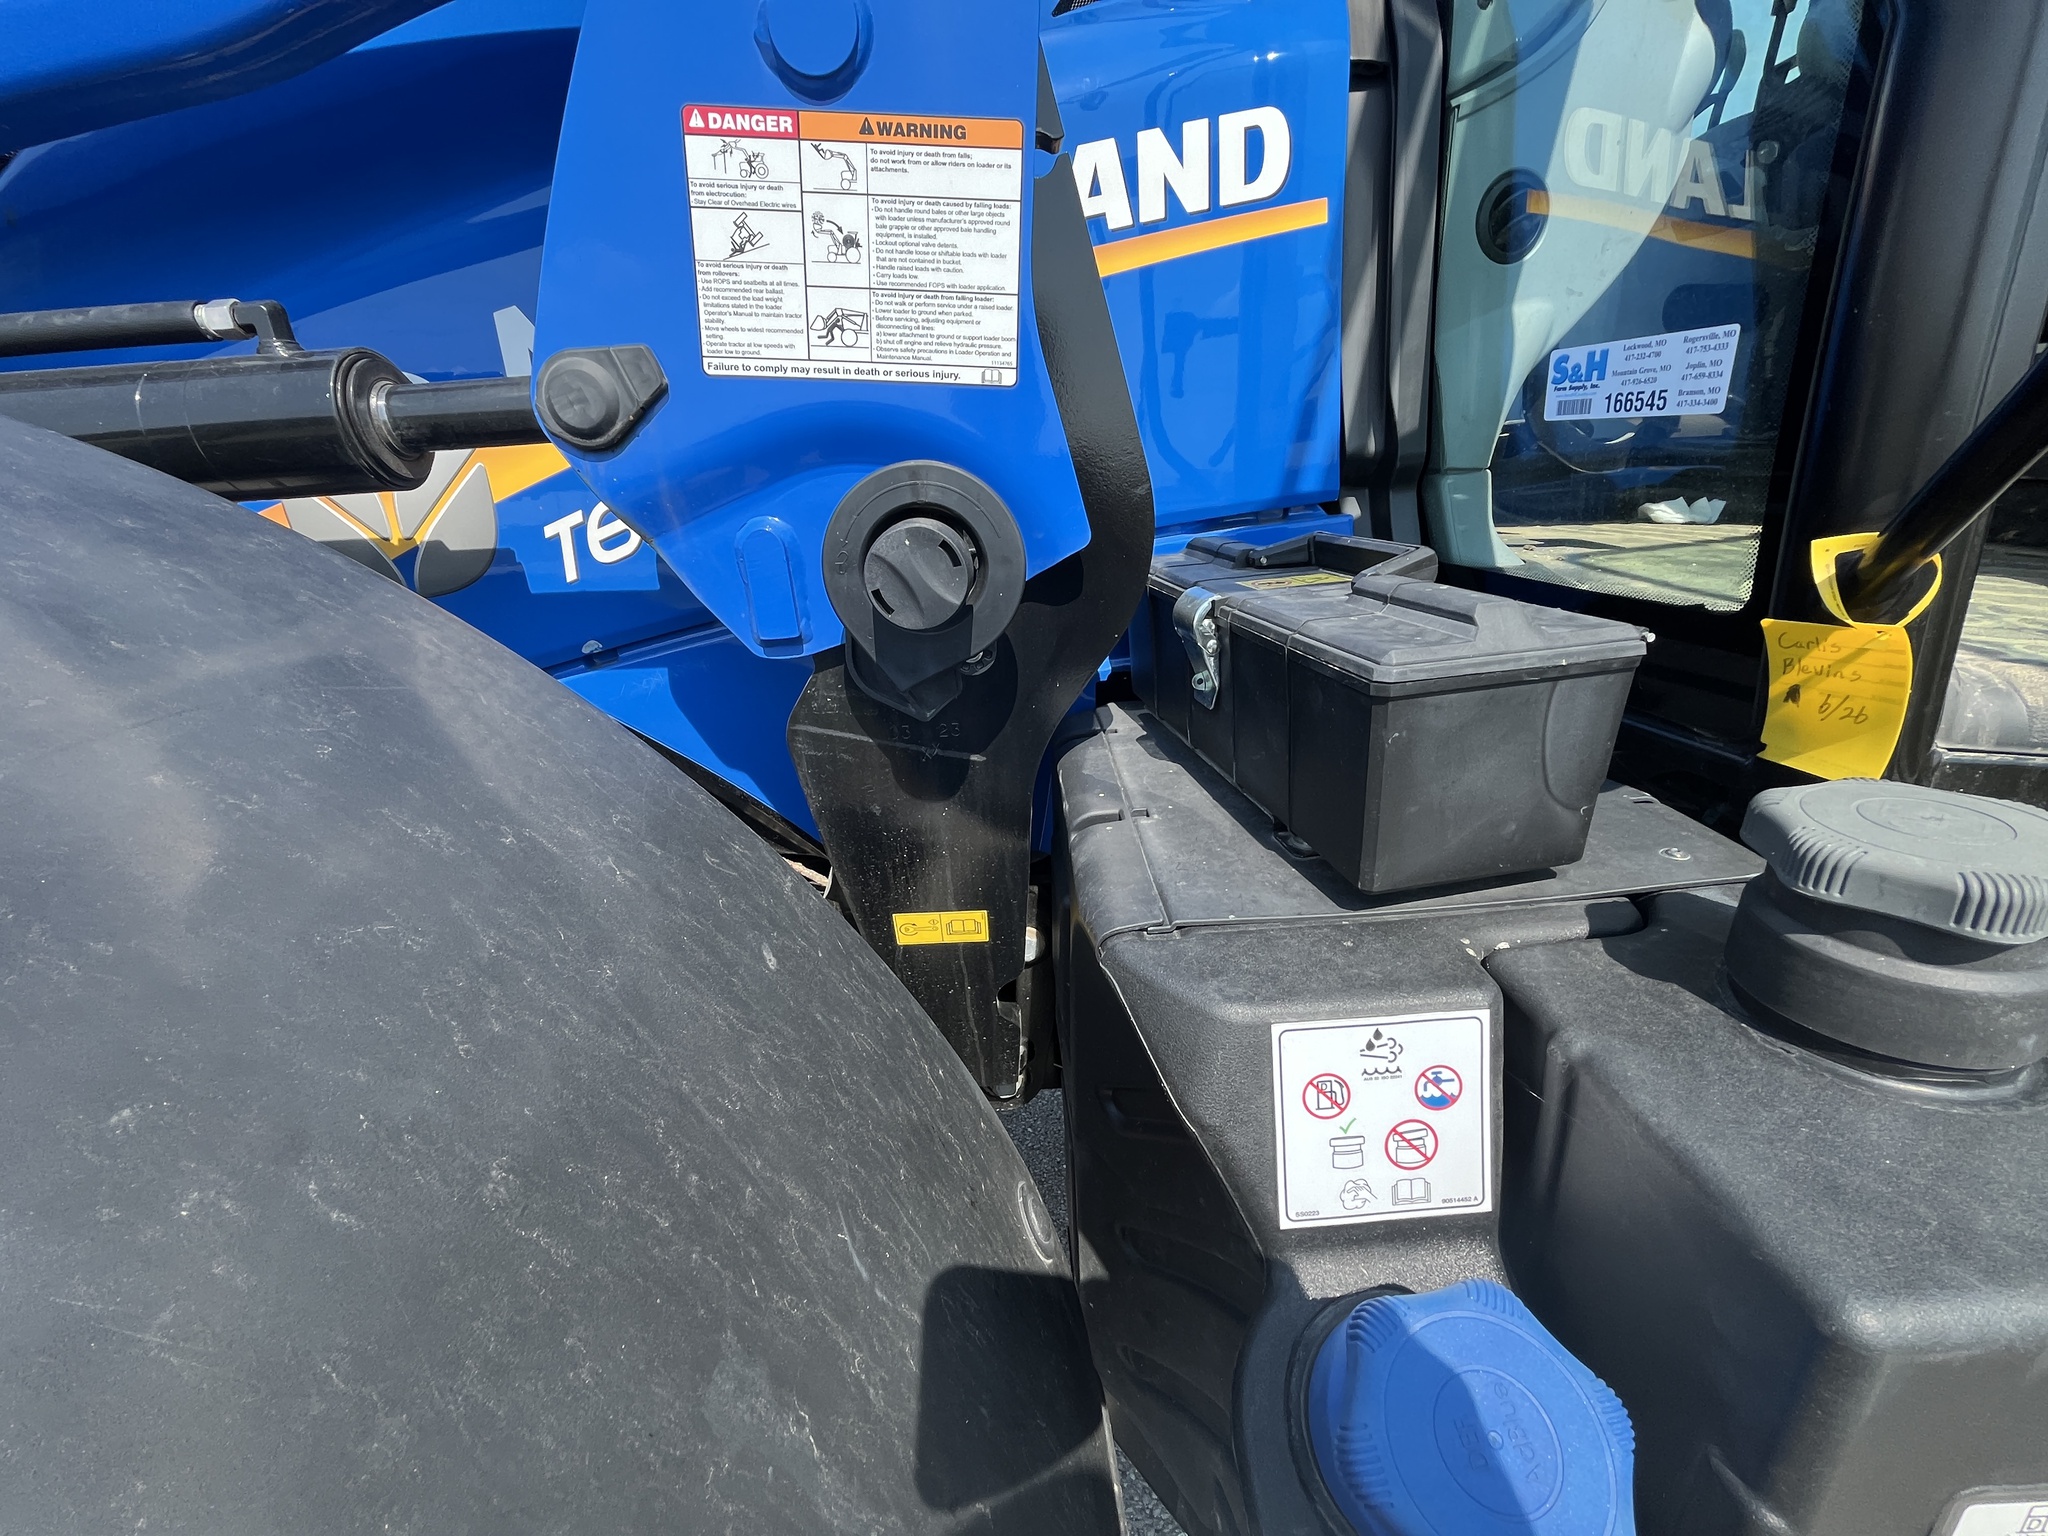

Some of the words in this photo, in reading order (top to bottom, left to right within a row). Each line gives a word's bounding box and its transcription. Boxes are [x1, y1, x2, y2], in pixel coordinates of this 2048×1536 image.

[708, 112, 793, 133] DANGER
[876, 121, 967, 140] WARNING
[896, 149, 914, 158] injury
[1072, 106, 1292, 232] AND
[739, 182, 758, 191] injury
[693, 197, 707, 206] Stay
[730, 199, 759, 207] Overhead
[758, 200, 780, 208] Electric
[897, 198, 915, 207] injury
[964, 201, 973, 209] by
[973, 201, 992, 210] falling
[969, 209, 984, 218] large
[984, 210, 1005, 218] objects
[744, 263, 762, 271] injury
[875, 271, 892, 279] Carry
[897, 292, 914, 300] injury
[955, 294, 973, 302] falling
[1722, 330, 1736, 338] MO
[1655, 339, 1667, 347] MO
[1551, 349, 1609, 385] S&H
[1709, 359, 1723, 367] MO
[706, 361, 739, 371] Failure
[741, 362, 752, 371] to
[753, 363, 788, 374] comply
[790, 366, 810, 375] may
[812, 365, 840, 374] result
[842, 366, 852, 375] in
[853, 366, 880, 376] death
[894, 368, 930, 378] serious
[932, 369, 961, 381] injury.
[1612, 368, 1637, 377] Mountain
[1707, 386, 1721, 395] MO
[1605, 389, 1669, 414] 166545
[1778, 632, 1842, 653] Carlis
[1782, 657, 1862, 682] Blevins
[940, 722, 960, 738] 23
